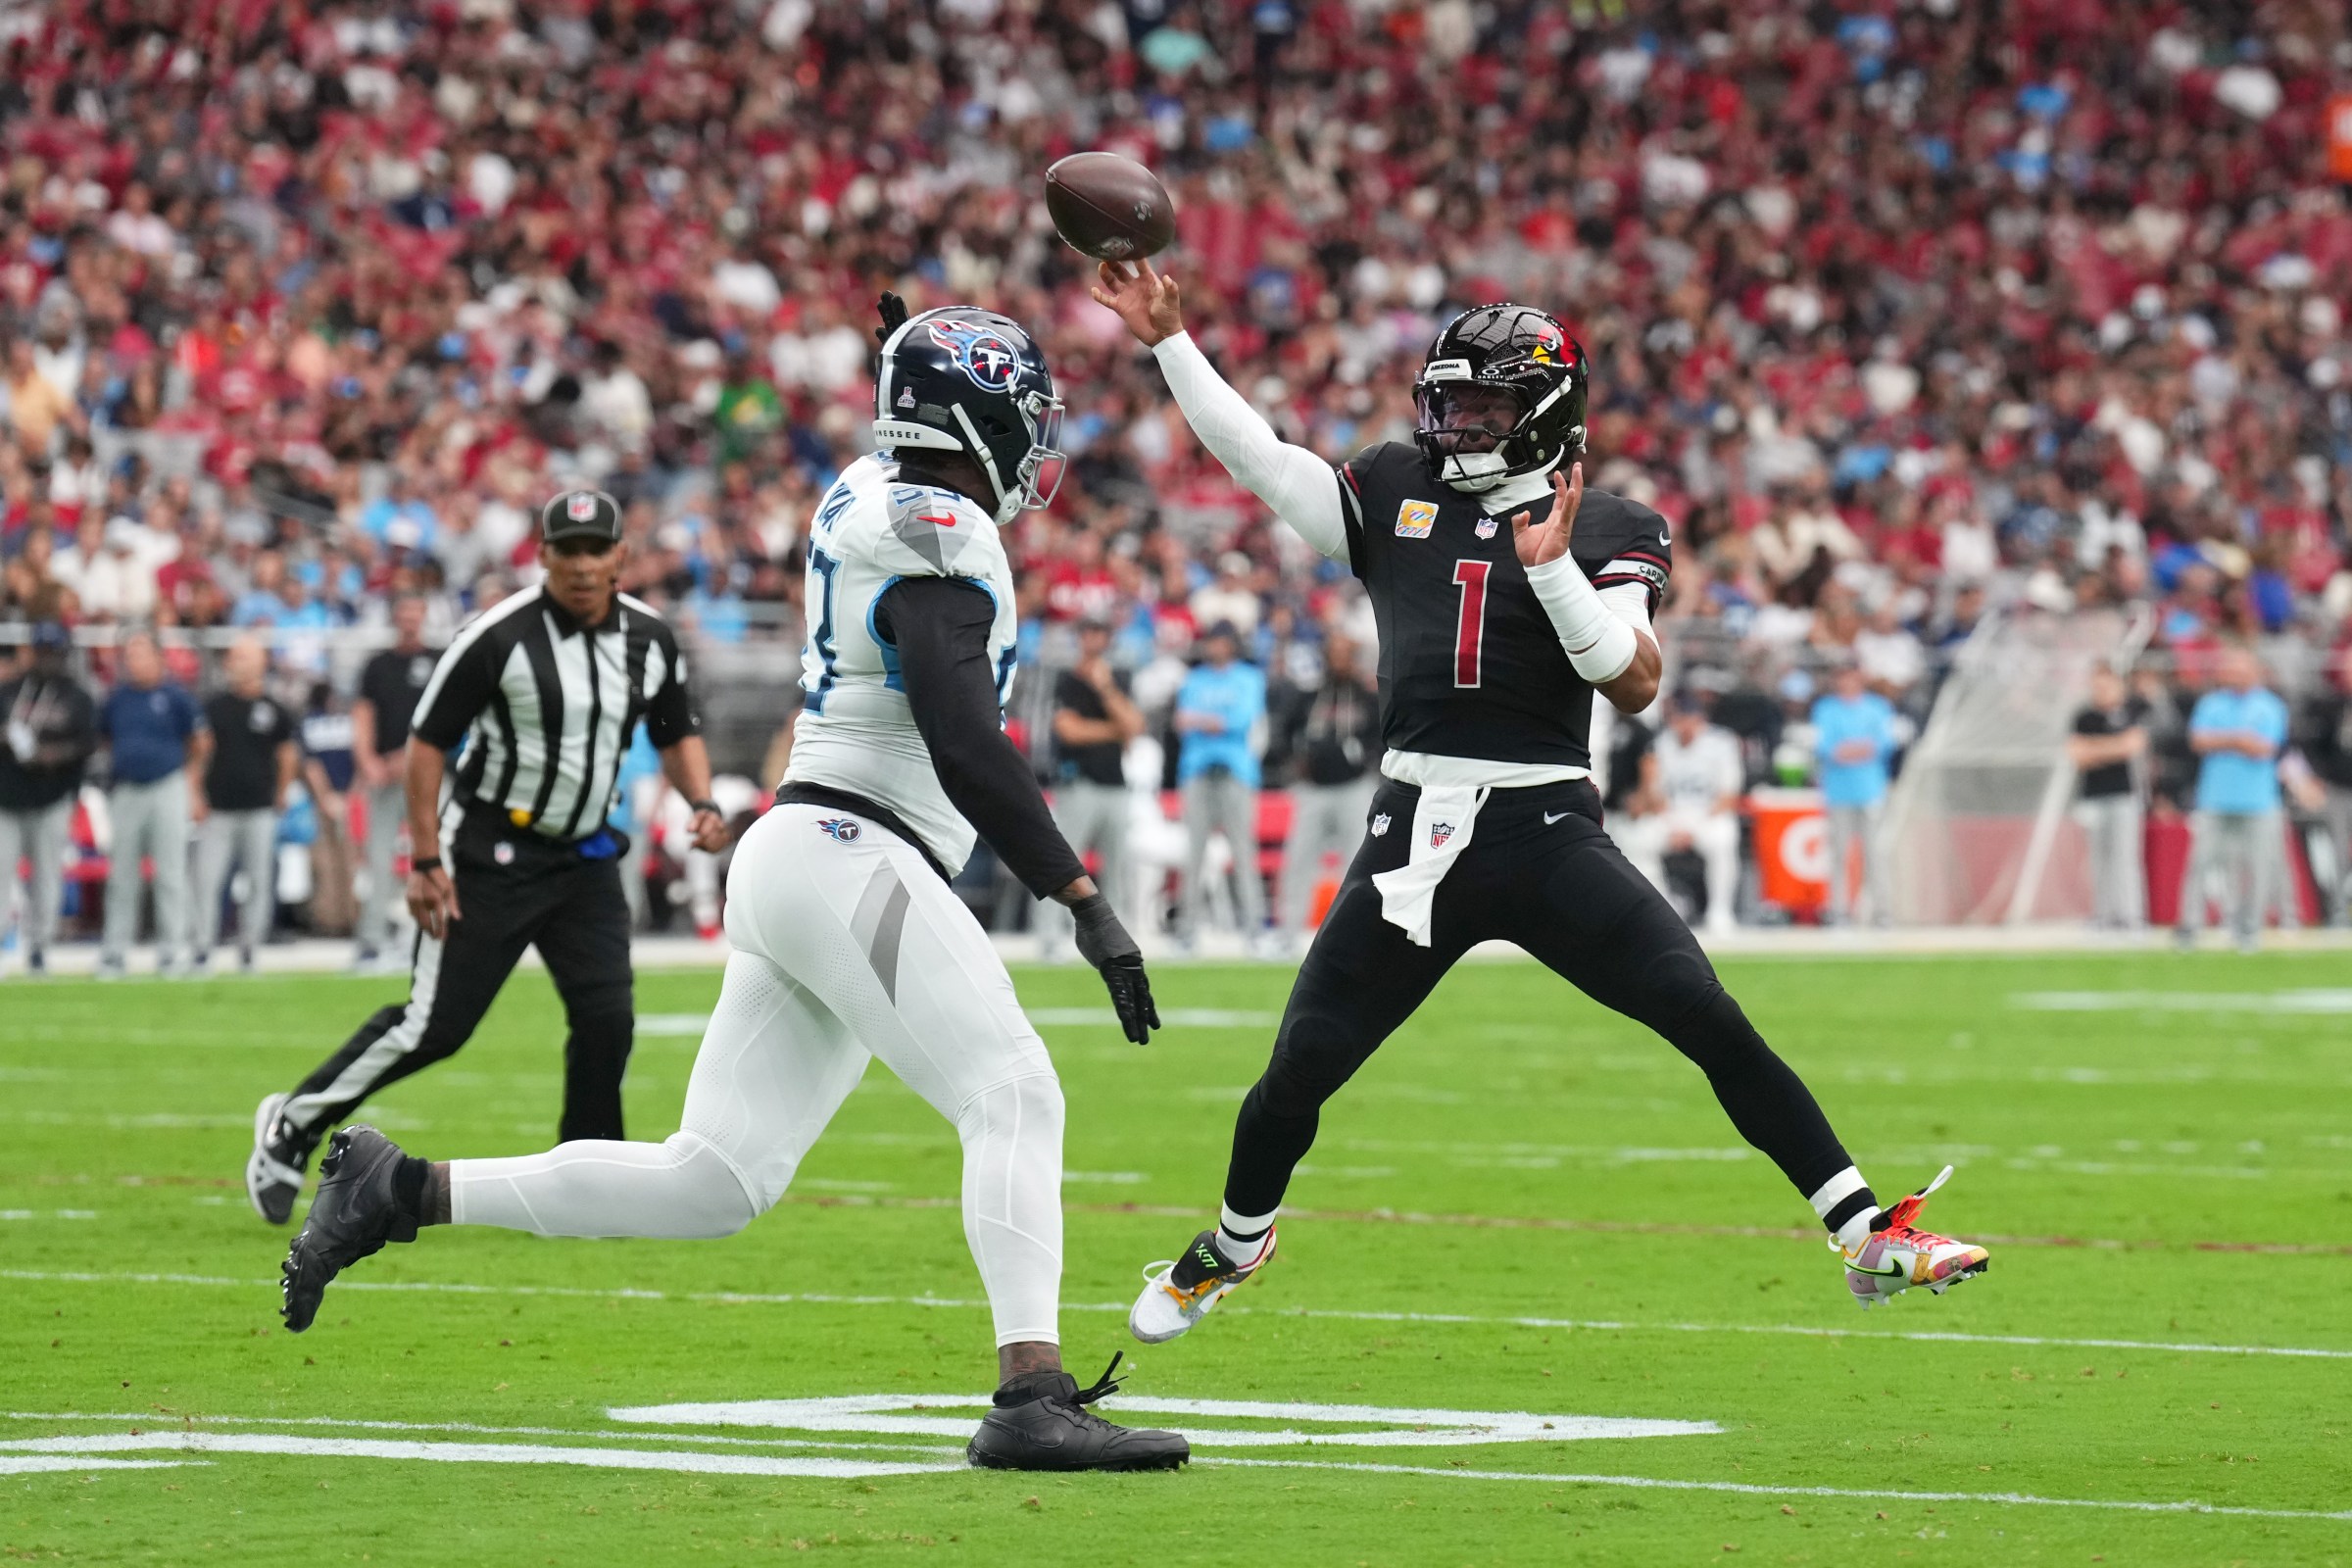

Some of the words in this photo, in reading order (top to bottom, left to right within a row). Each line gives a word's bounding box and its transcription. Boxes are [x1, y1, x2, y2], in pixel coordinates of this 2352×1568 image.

[1430, 363, 1460, 371] ARIZONA
[875, 430, 920, 440] NESSEE
[1401, 502, 1434, 528] C
[1451, 559, 1493, 688] 1
